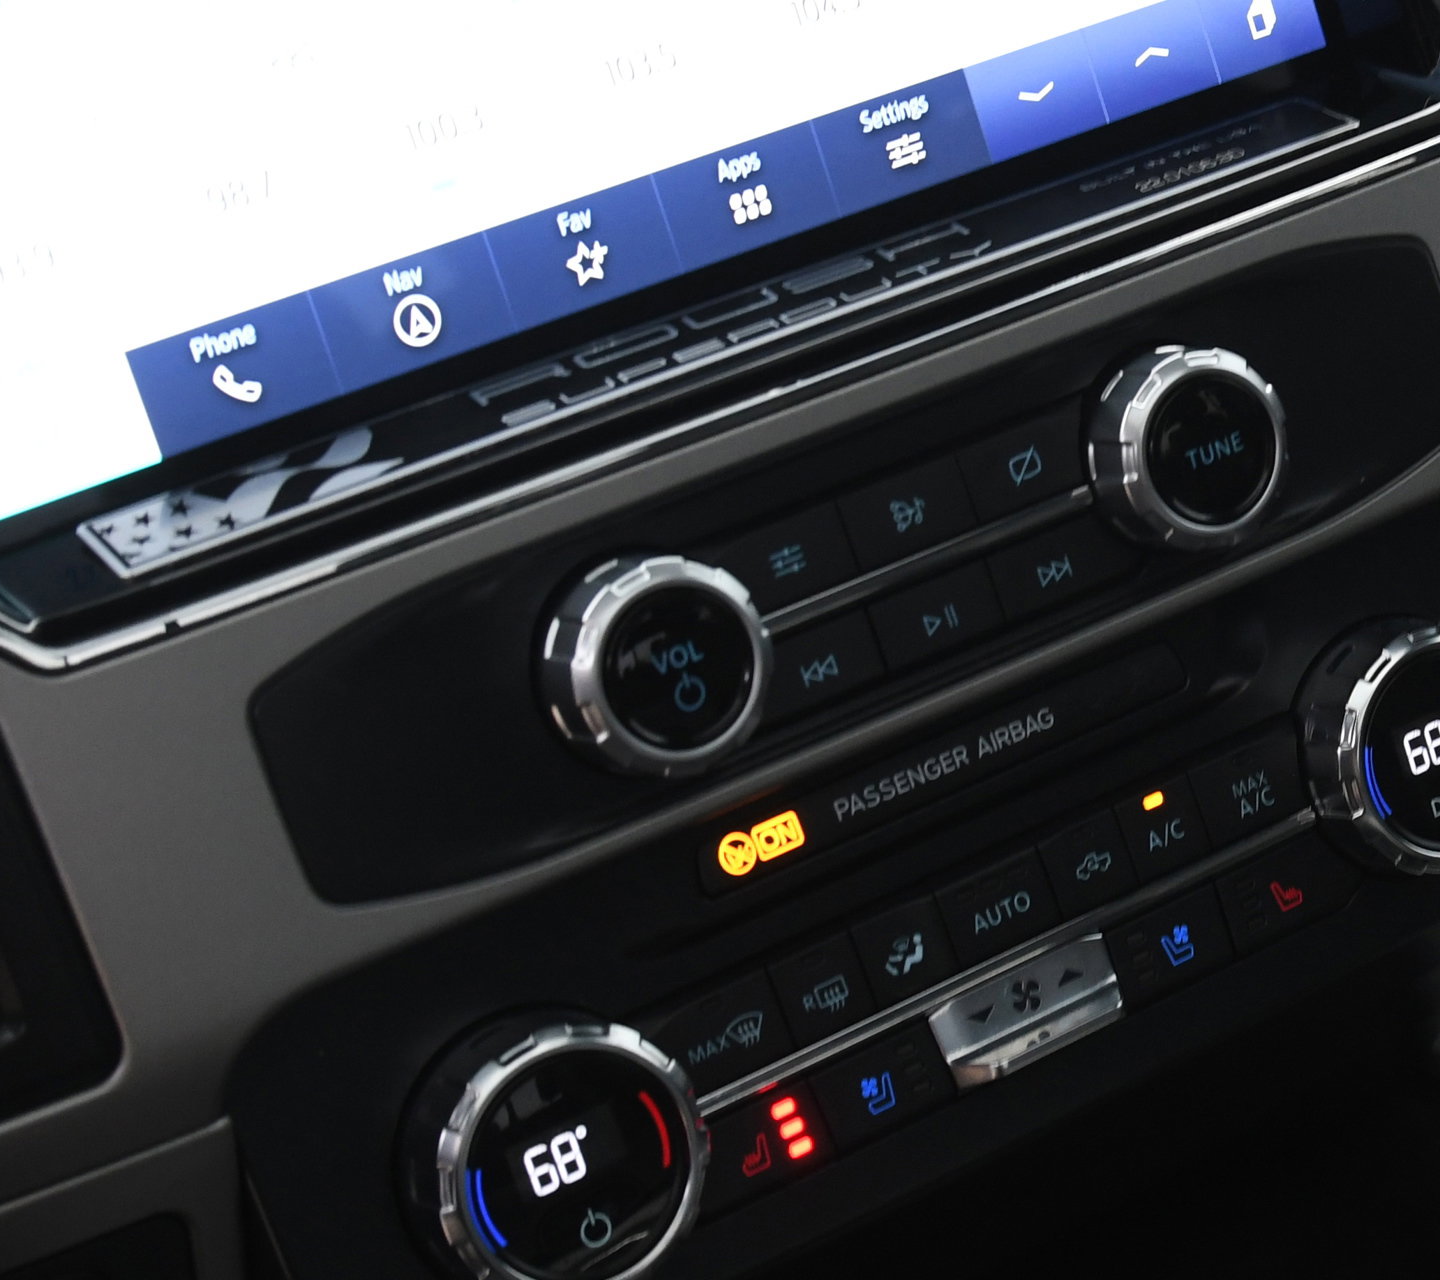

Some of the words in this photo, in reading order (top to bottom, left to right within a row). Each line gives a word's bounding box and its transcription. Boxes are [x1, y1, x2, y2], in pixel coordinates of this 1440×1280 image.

[858, 92, 930, 135] Settings
[716, 147, 762, 185] Apps
[555, 205, 594, 238] Fav
[382, 262, 424, 297] Nav
[188, 318, 257, 364] Phone
[1185, 431, 1243, 469] TUNE
[649, 641, 704, 678] VOL
[833, 742, 971, 823] PASSENGER
[977, 706, 1056, 759] AIRBAG
[1232, 769, 1268, 800] MAX
[1241, 785, 1275, 819] A/C
[759, 817, 800, 855] ON
[1149, 818, 1185, 852] A/C
[974, 892, 1032, 935] AUTO
[688, 1034, 731, 1064] MAX
